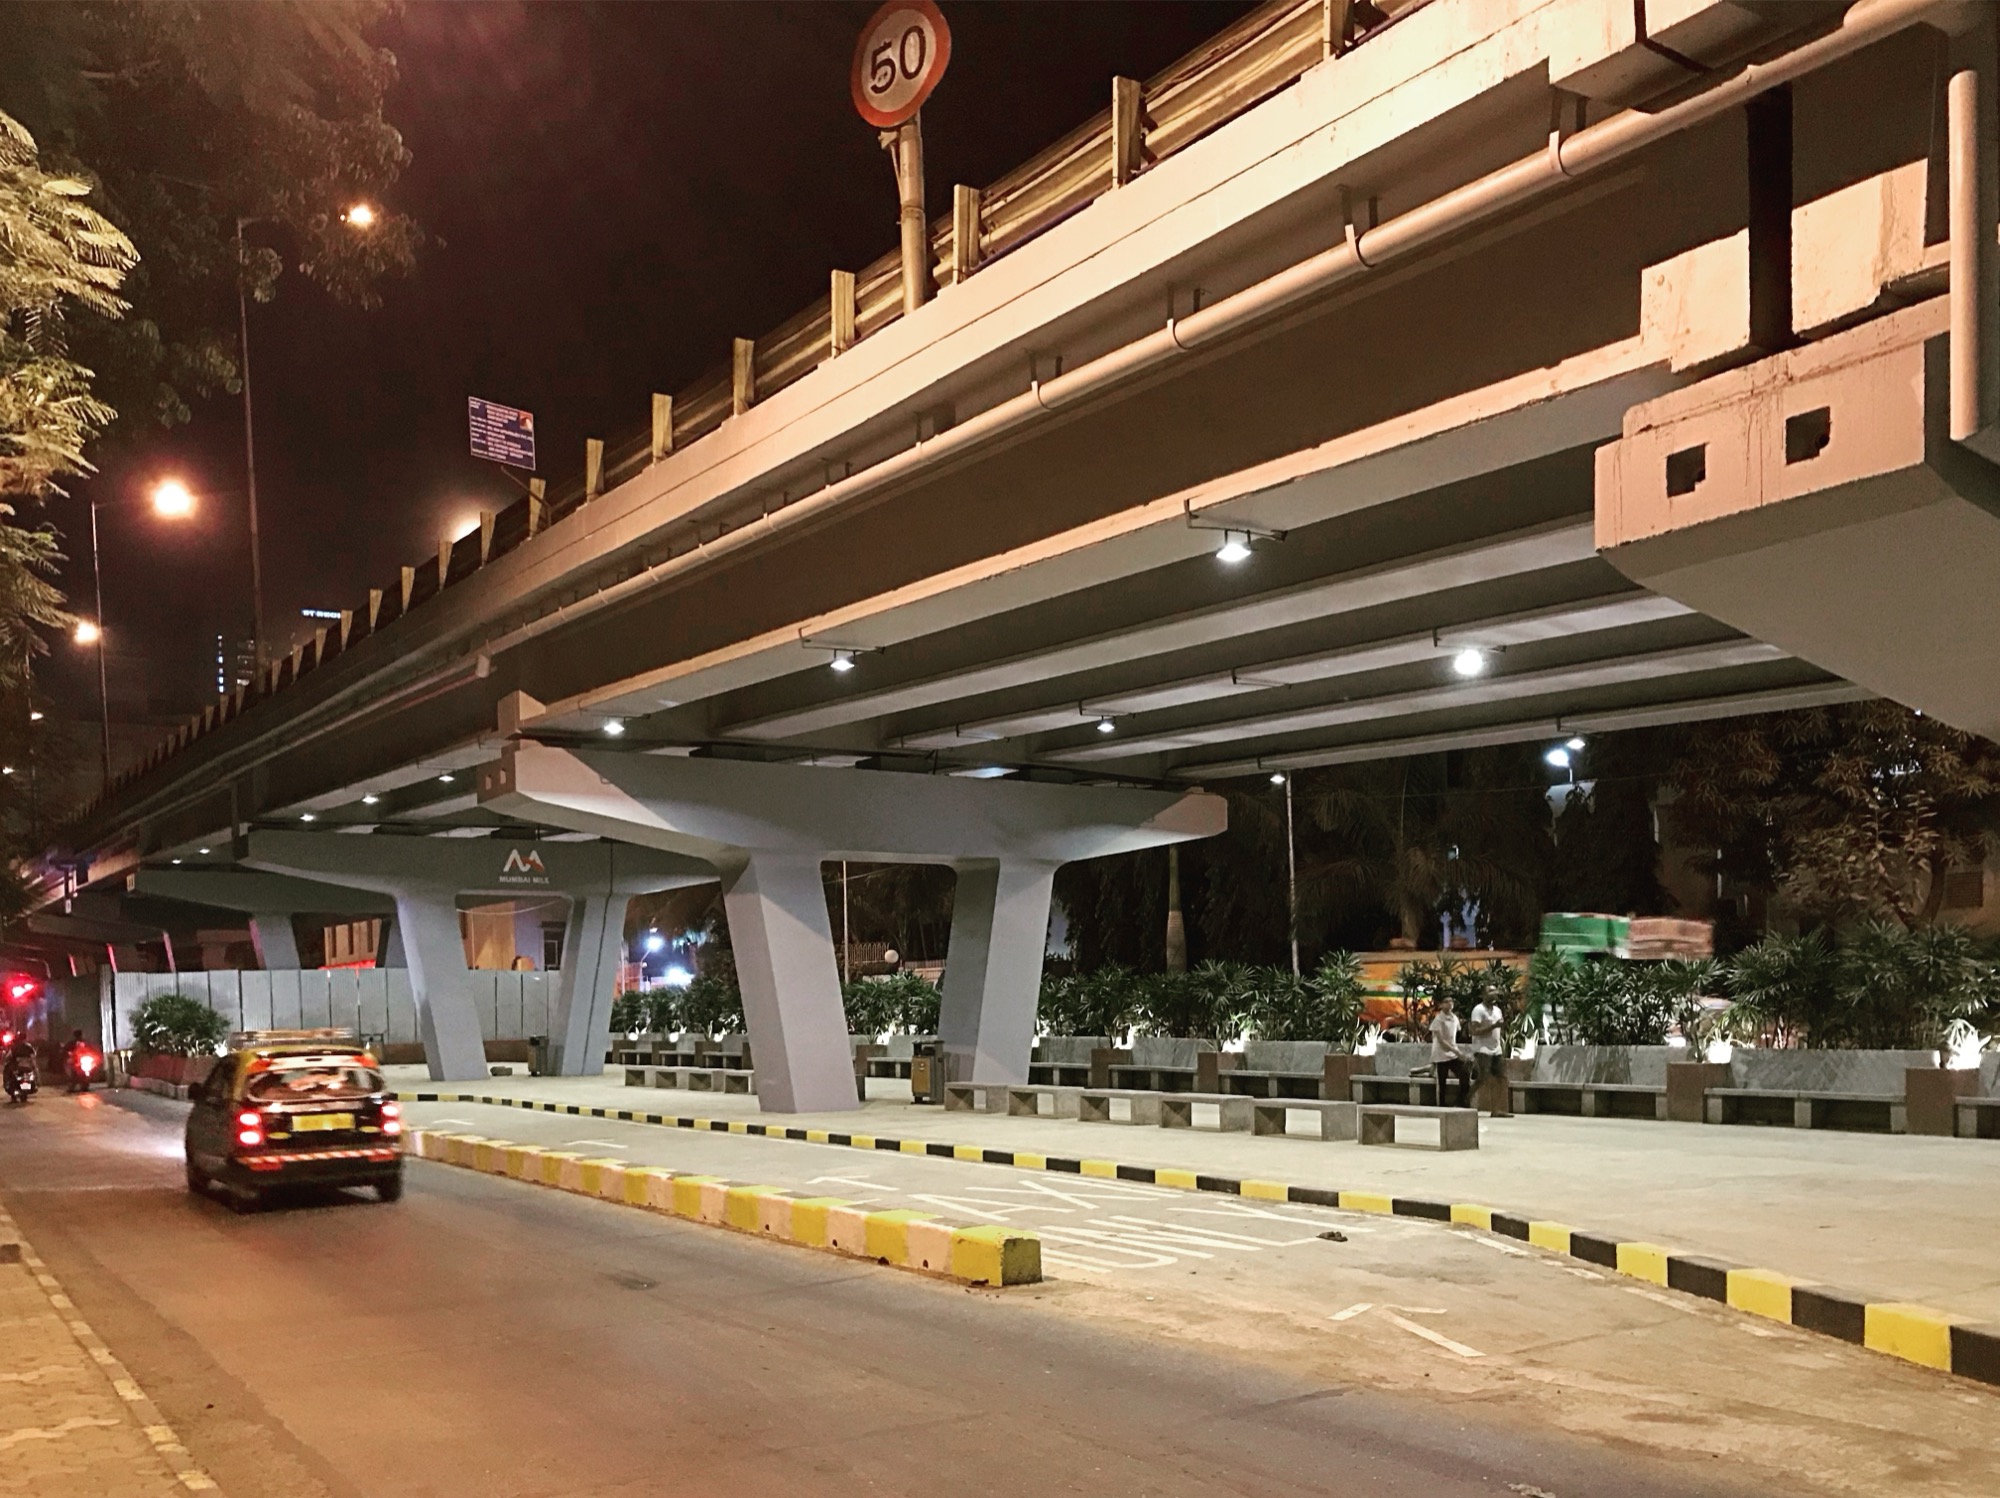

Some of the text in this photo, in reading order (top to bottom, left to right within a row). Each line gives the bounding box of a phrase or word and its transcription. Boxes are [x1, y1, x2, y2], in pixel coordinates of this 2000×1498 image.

[870, 25, 927, 94] 50
[499, 875, 550, 884] MUMBAI MILE
[847, 1177, 1184, 1222] AXI
